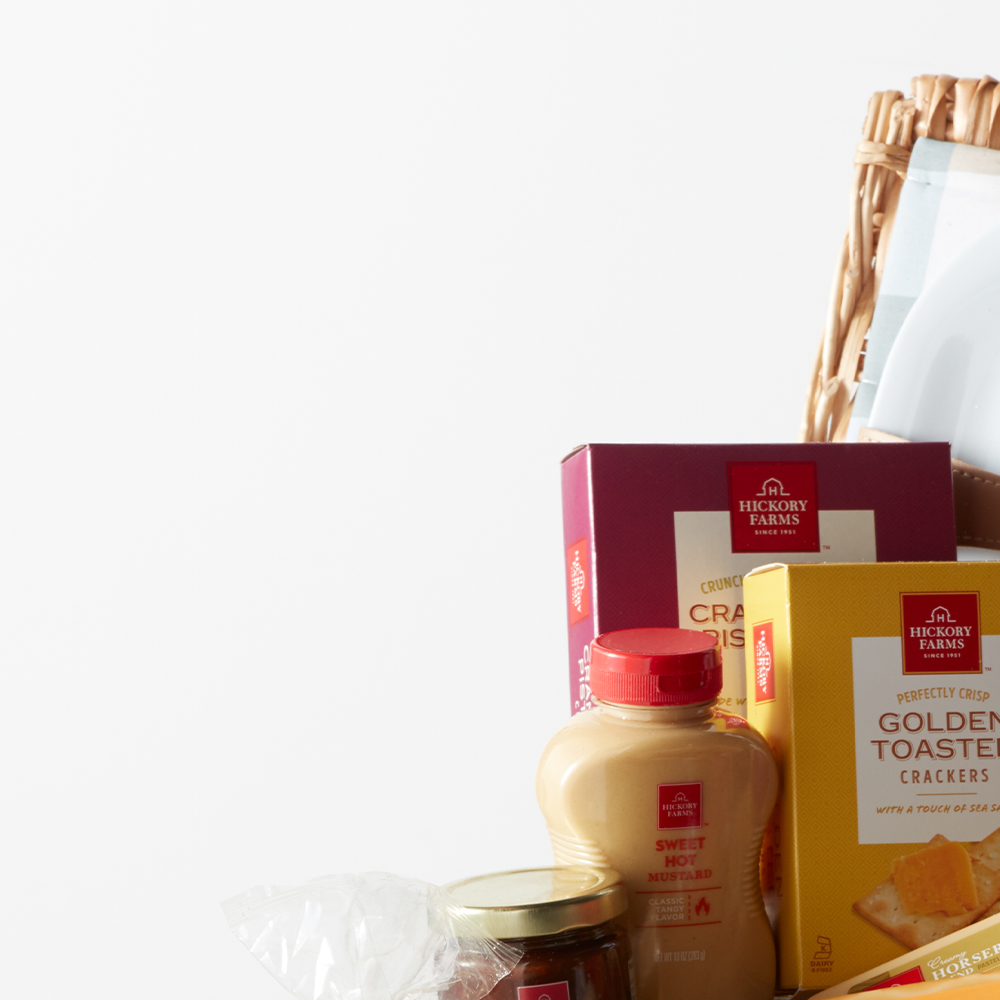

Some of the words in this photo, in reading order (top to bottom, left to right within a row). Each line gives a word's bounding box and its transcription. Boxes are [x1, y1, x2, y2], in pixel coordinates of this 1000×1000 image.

[739, 500, 808, 512] HICKORY
[750, 514, 800, 526] FARMS
[910, 626, 972, 638] HICKORY
[919, 639, 964, 650] FARMS
[896, 687, 956, 704] PERFECTLY
[958, 687, 990, 703] CRISP
[900, 768, 989, 784] CRACKERS
[662, 802, 698, 811] HICKORY
[876, 806, 904, 814] WITH
[906, 806, 914, 814] A
[917, 805, 950, 814] TOUCH
[954, 804, 968, 814] OF
[970, 804, 988, 812] SEA
[667, 810, 694, 818] FARMS
[655, 837, 706, 852] SWEET
[664, 854, 697, 868] HOT
[647, 869, 712, 882] MUSTARD
[648, 898, 685, 906] CLASSIC
[650, 913, 685, 921] FLAVOR
[926, 950, 967, 970] Creamy
